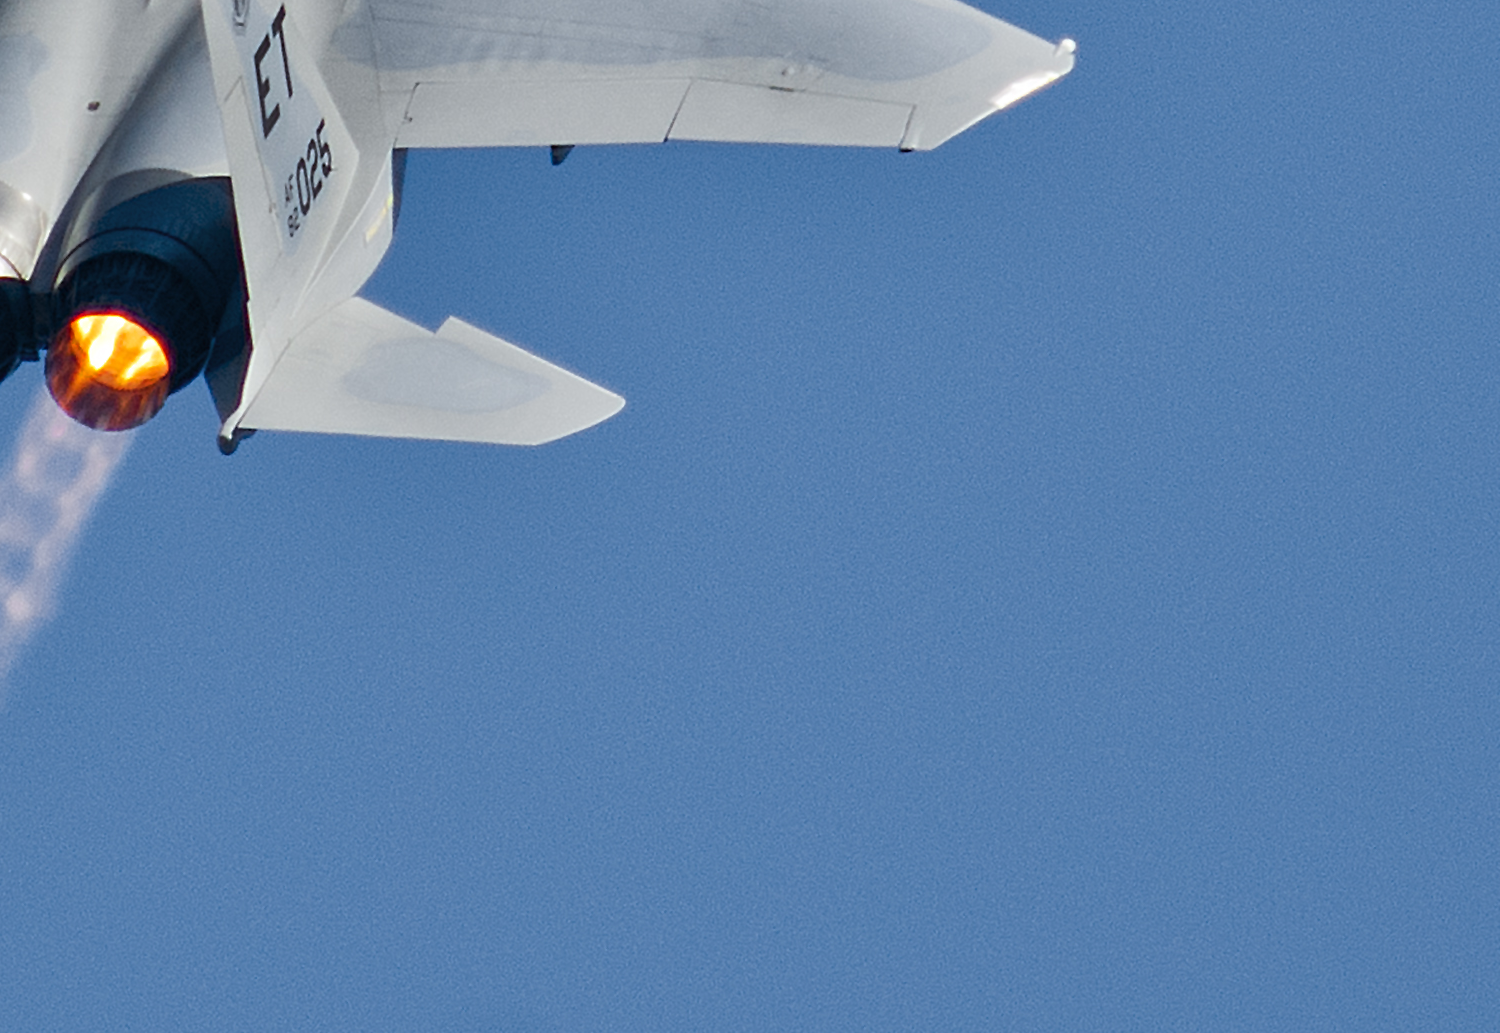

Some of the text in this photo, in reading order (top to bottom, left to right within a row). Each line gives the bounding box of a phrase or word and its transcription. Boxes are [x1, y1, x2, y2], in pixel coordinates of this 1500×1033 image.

[254, 2, 293, 139] ET
[284, 173, 294, 208] AF
[297, 117, 332, 216] 025
